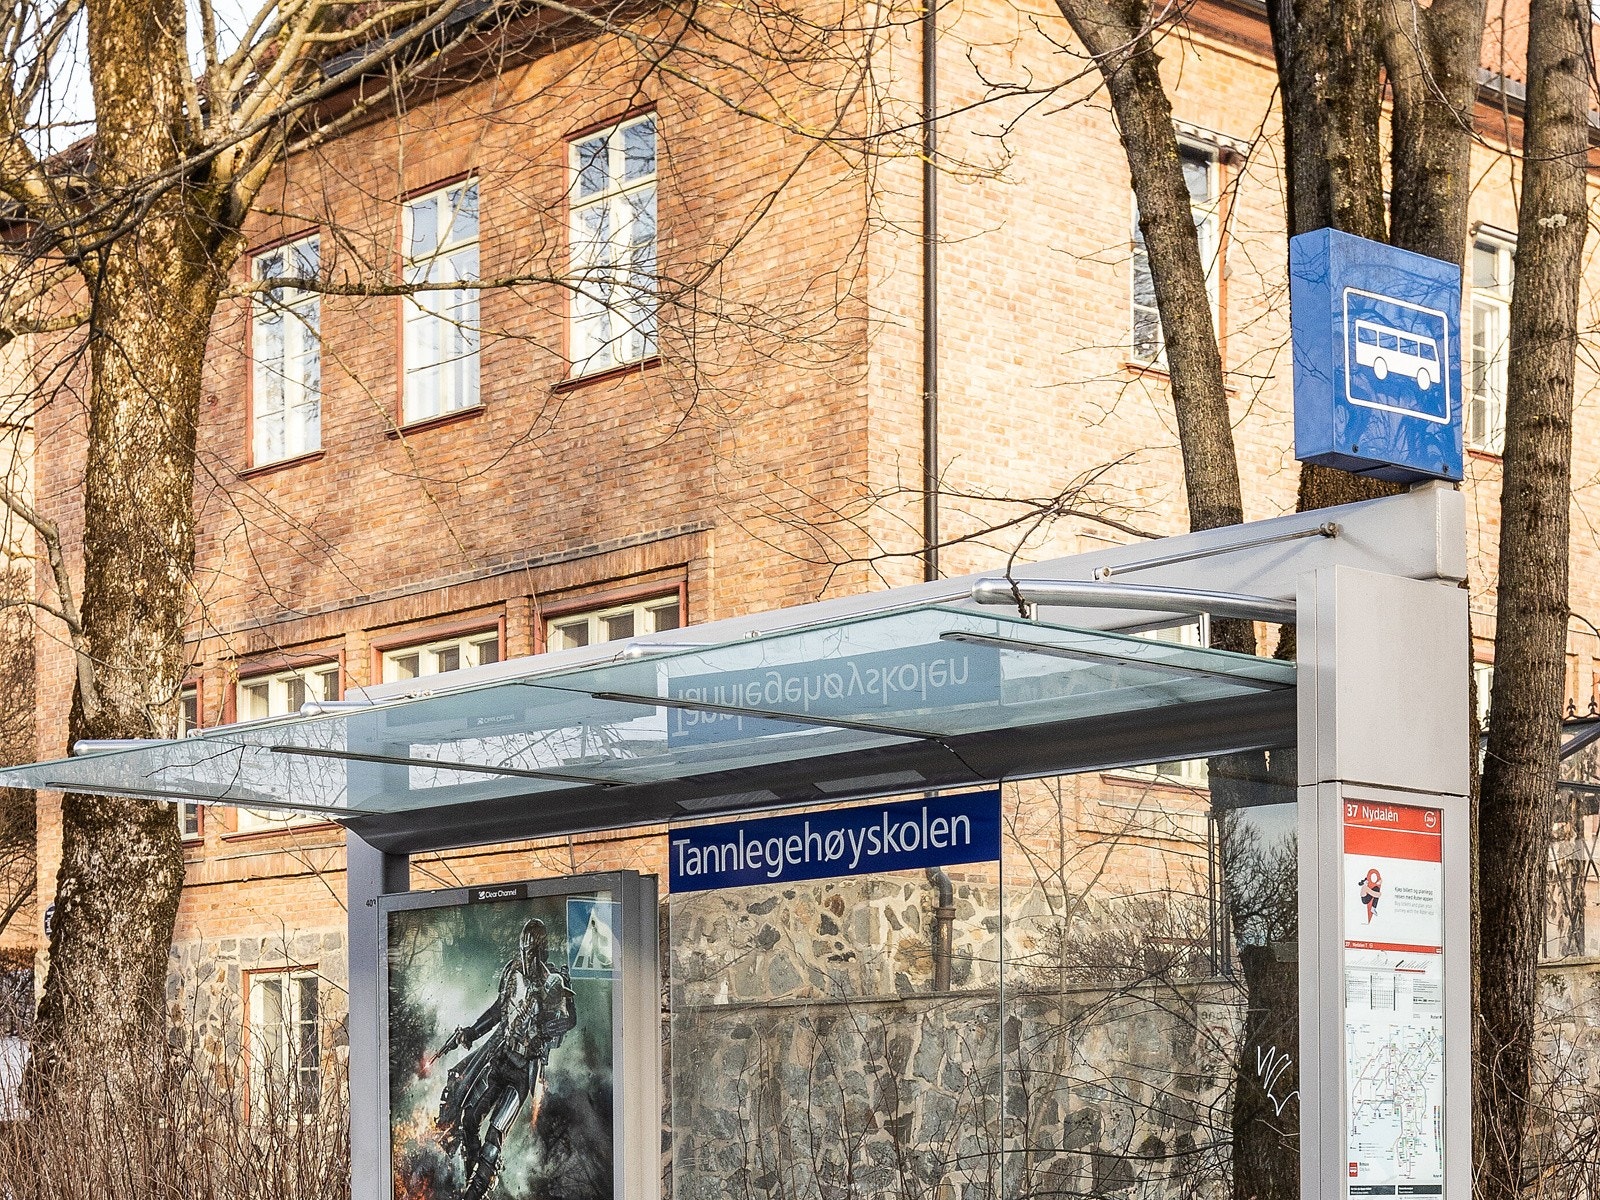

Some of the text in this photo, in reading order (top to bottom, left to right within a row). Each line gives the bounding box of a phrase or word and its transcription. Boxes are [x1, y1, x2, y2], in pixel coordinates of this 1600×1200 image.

[1346, 804, 1399, 823] 37 Nydalen
[672, 806, 971, 878] Tannlegehøyskolen
